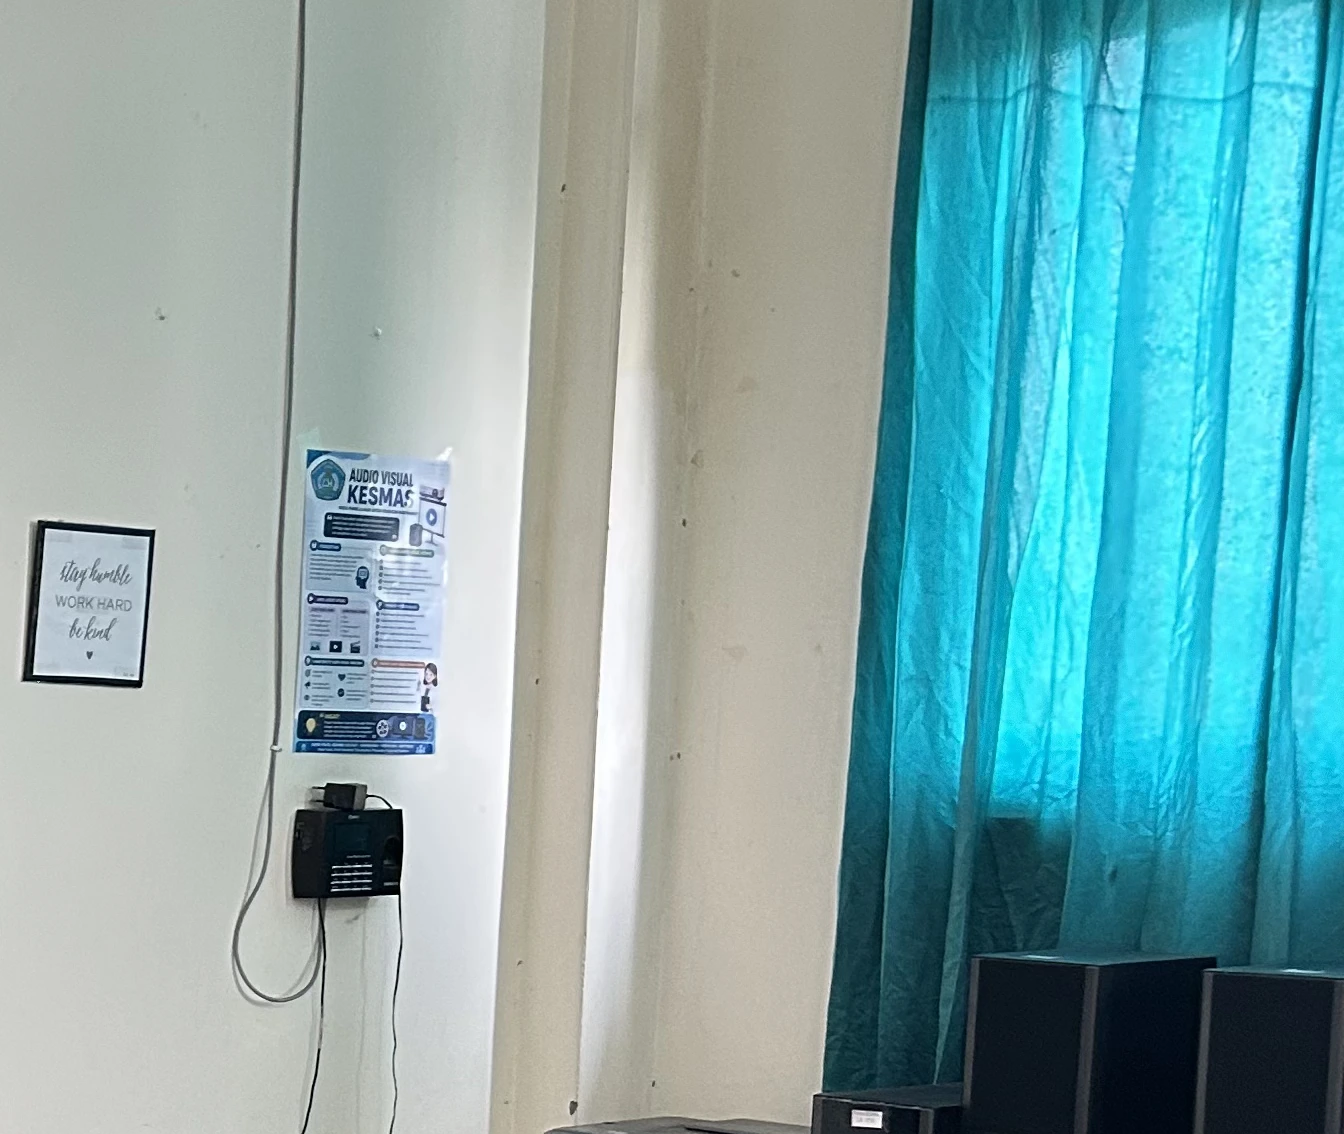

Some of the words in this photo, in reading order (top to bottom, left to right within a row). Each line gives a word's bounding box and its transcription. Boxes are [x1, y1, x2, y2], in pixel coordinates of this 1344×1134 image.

[349, 468, 379, 484] AUDIO
[381, 471, 413, 487] VISUAL
[347, 484, 415, 508] KESMAS
[60, 560, 88, 592] stay
[89, 558, 133, 586] humble
[55, 595, 93, 610] WORK
[97, 598, 133, 612] HARD
[69, 617, 83, 639] be
[83, 616, 118, 641] kind
